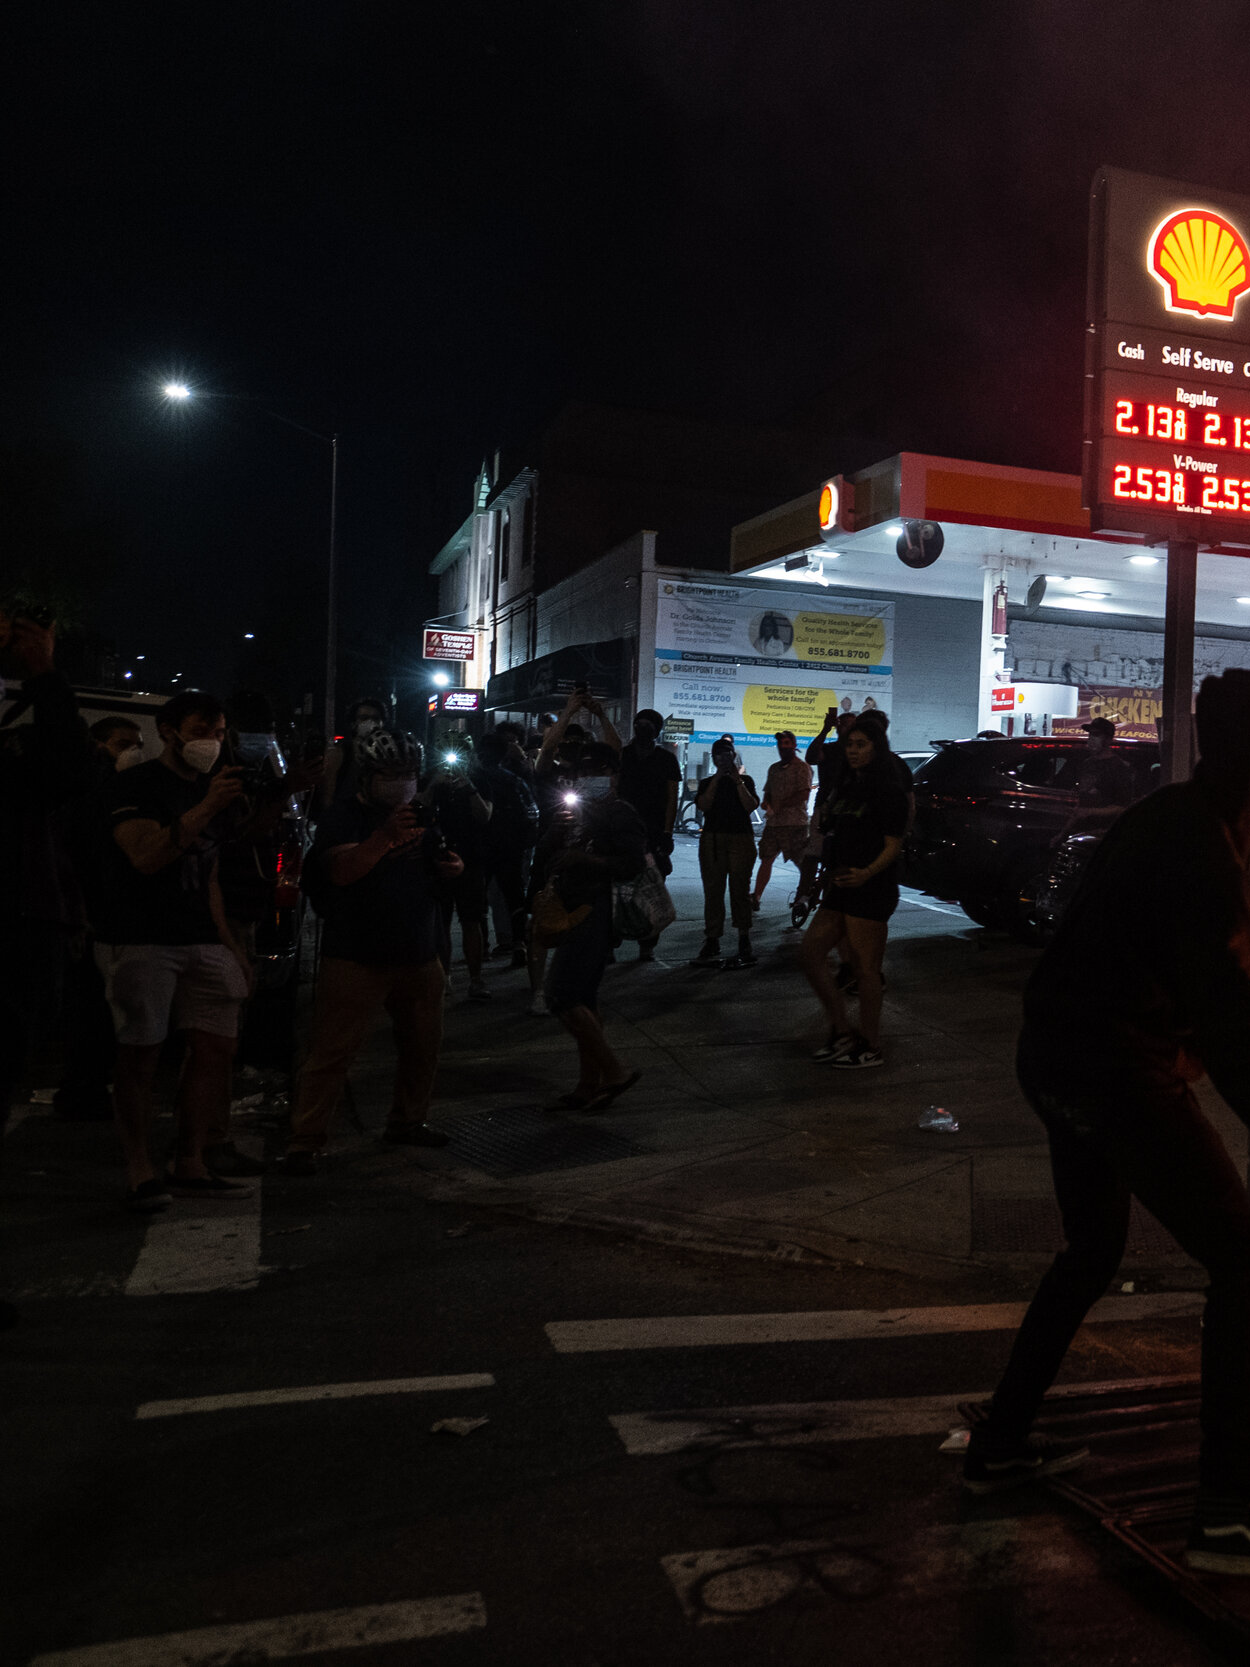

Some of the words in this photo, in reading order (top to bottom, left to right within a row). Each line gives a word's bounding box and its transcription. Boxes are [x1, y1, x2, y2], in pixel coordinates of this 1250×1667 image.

[1117, 341, 1145, 361] Cash
[1161, 345, 1192, 367] Self
[1193, 350, 1234, 375] Serve
[1176, 387, 1219, 409] Regular
[1172, 453, 1219, 474] V-Power
[677, 585, 716, 596] BRIGHTPOINT
[705, 616, 736, 624] Johnson
[802, 617, 826, 625] Quality
[828, 618, 849, 626] Health
[851, 621, 878, 629] Services
[807, 646, 870, 659] 855.681.8700
[673, 664, 713, 674] BRIGHTPOINT
[714, 667, 737, 676] HEALTH
[681, 682, 699, 690] Call
[764, 687, 794, 695] Services
[673, 692, 731, 703] 855.681.8700
[768, 694, 789, 702] whole
[1089, 695, 1163, 725] CHICKEN
